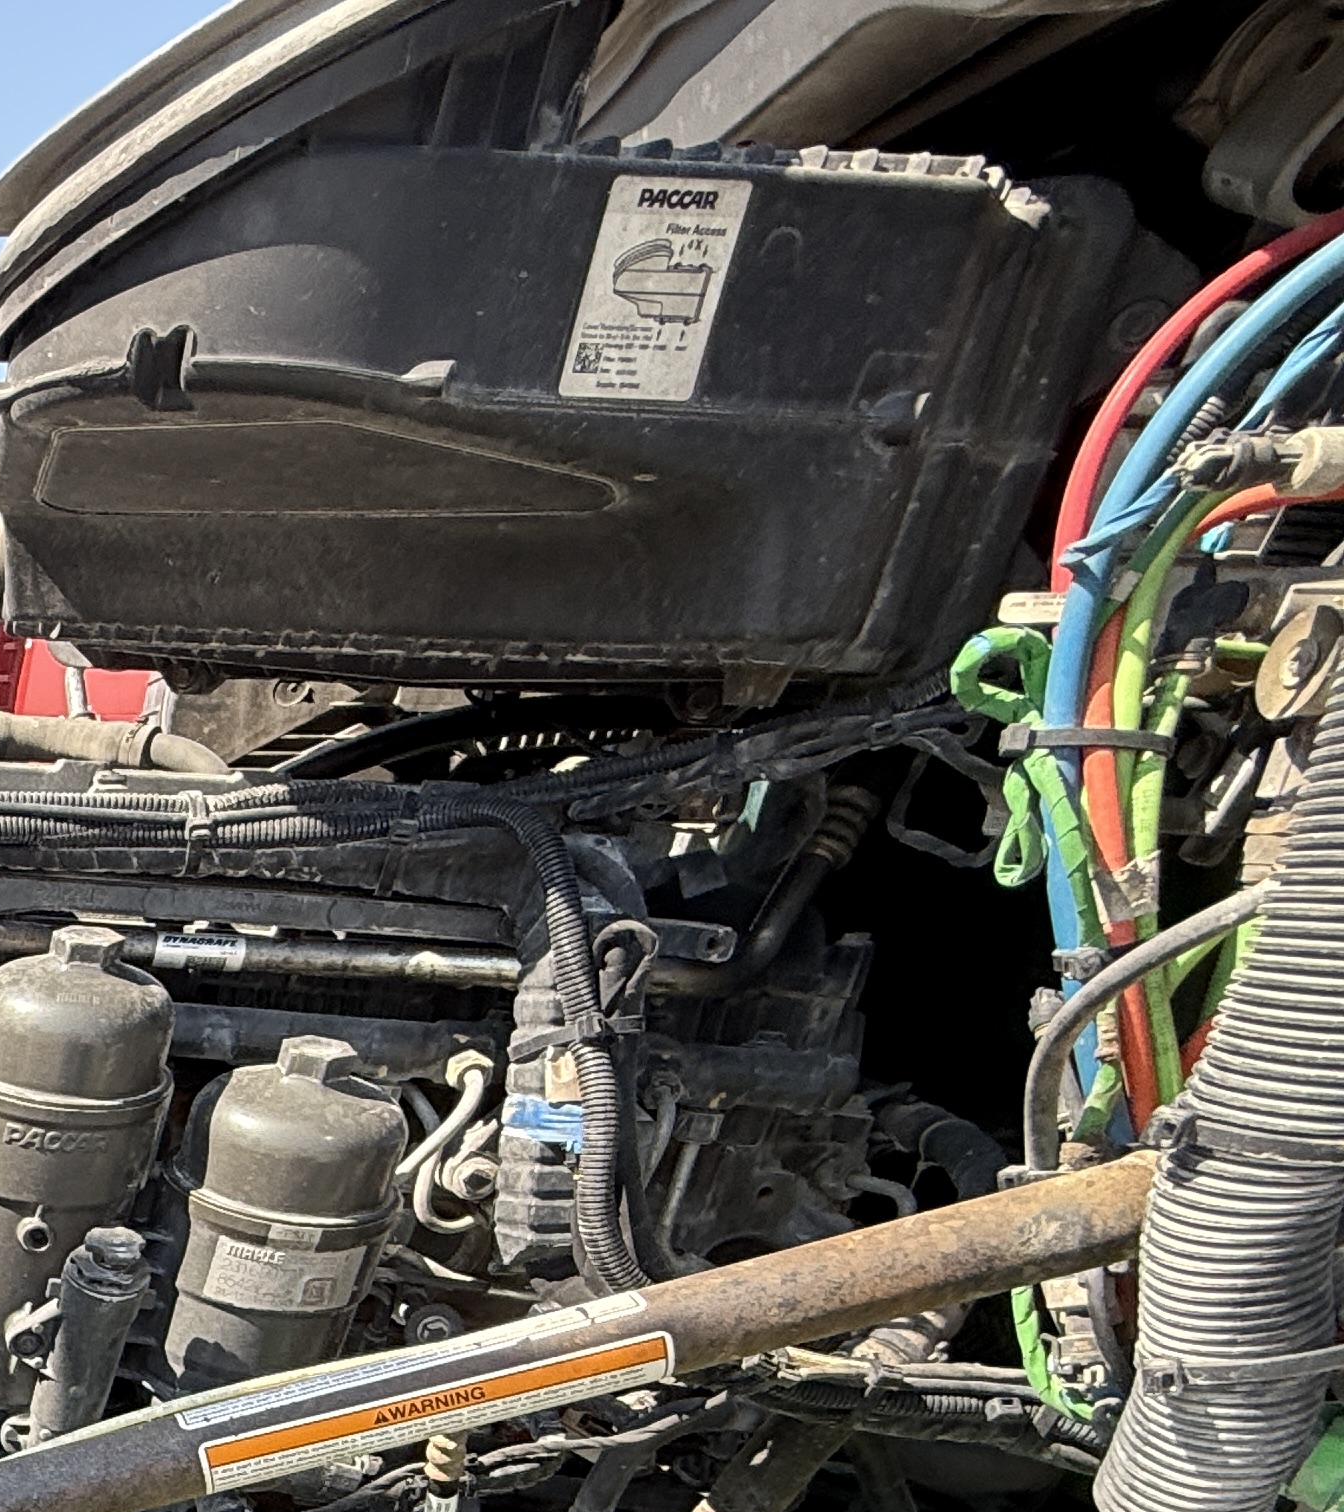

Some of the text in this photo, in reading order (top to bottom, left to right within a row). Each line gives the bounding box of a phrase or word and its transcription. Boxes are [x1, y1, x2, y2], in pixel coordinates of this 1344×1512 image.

[637, 188, 719, 209] PACCAR
[666, 223, 727, 236] Filter Access
[226, 1244, 287, 1265] MAHLE
[388, 1386, 486, 1421] WARNING
